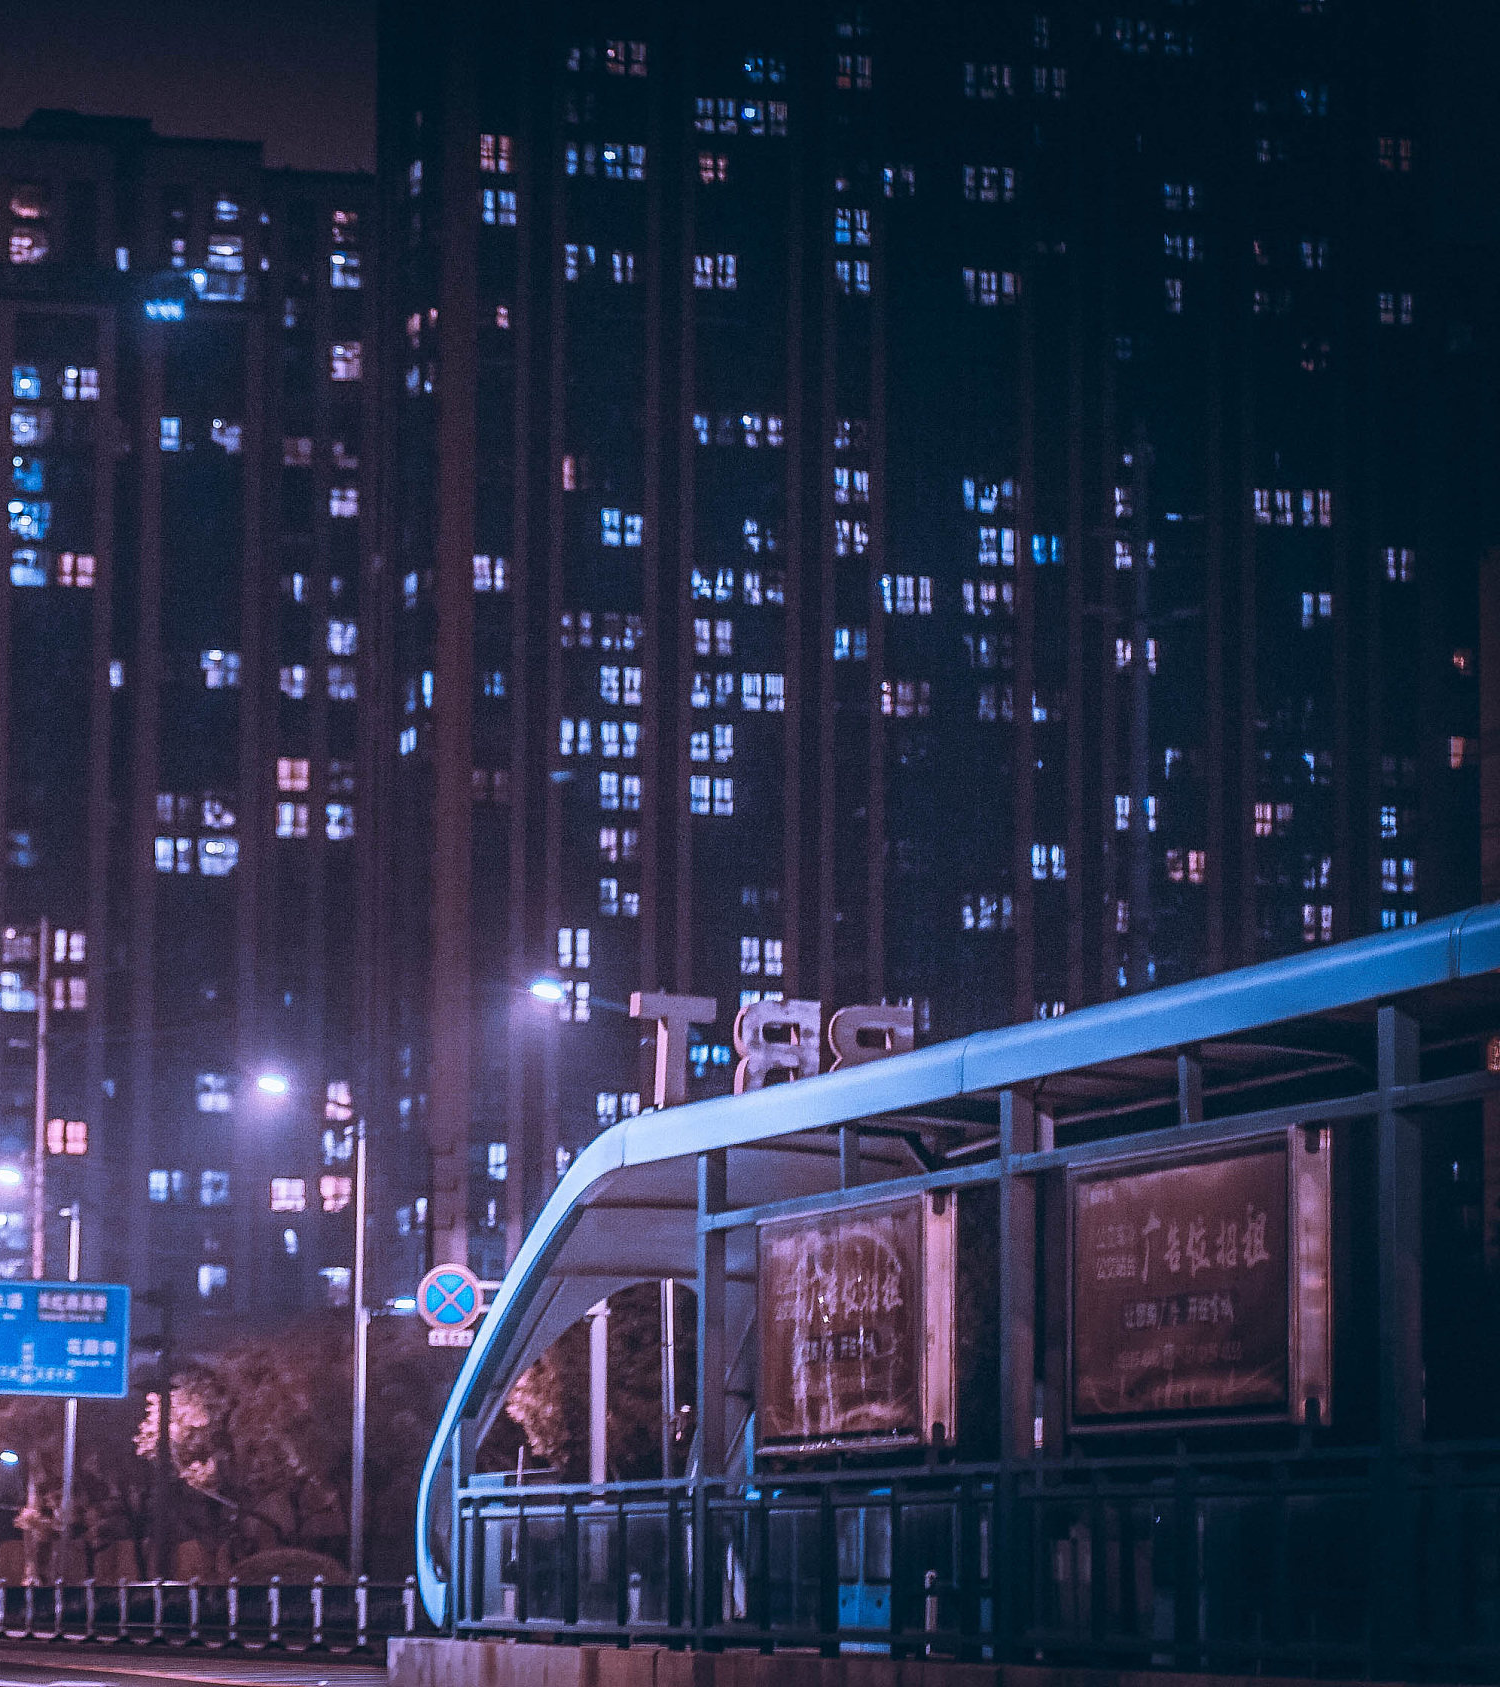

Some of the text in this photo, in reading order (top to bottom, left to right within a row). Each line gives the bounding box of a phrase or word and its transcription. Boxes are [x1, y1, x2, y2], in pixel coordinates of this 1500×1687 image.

[1142, 1205, 1271, 1284] 广告位招租
